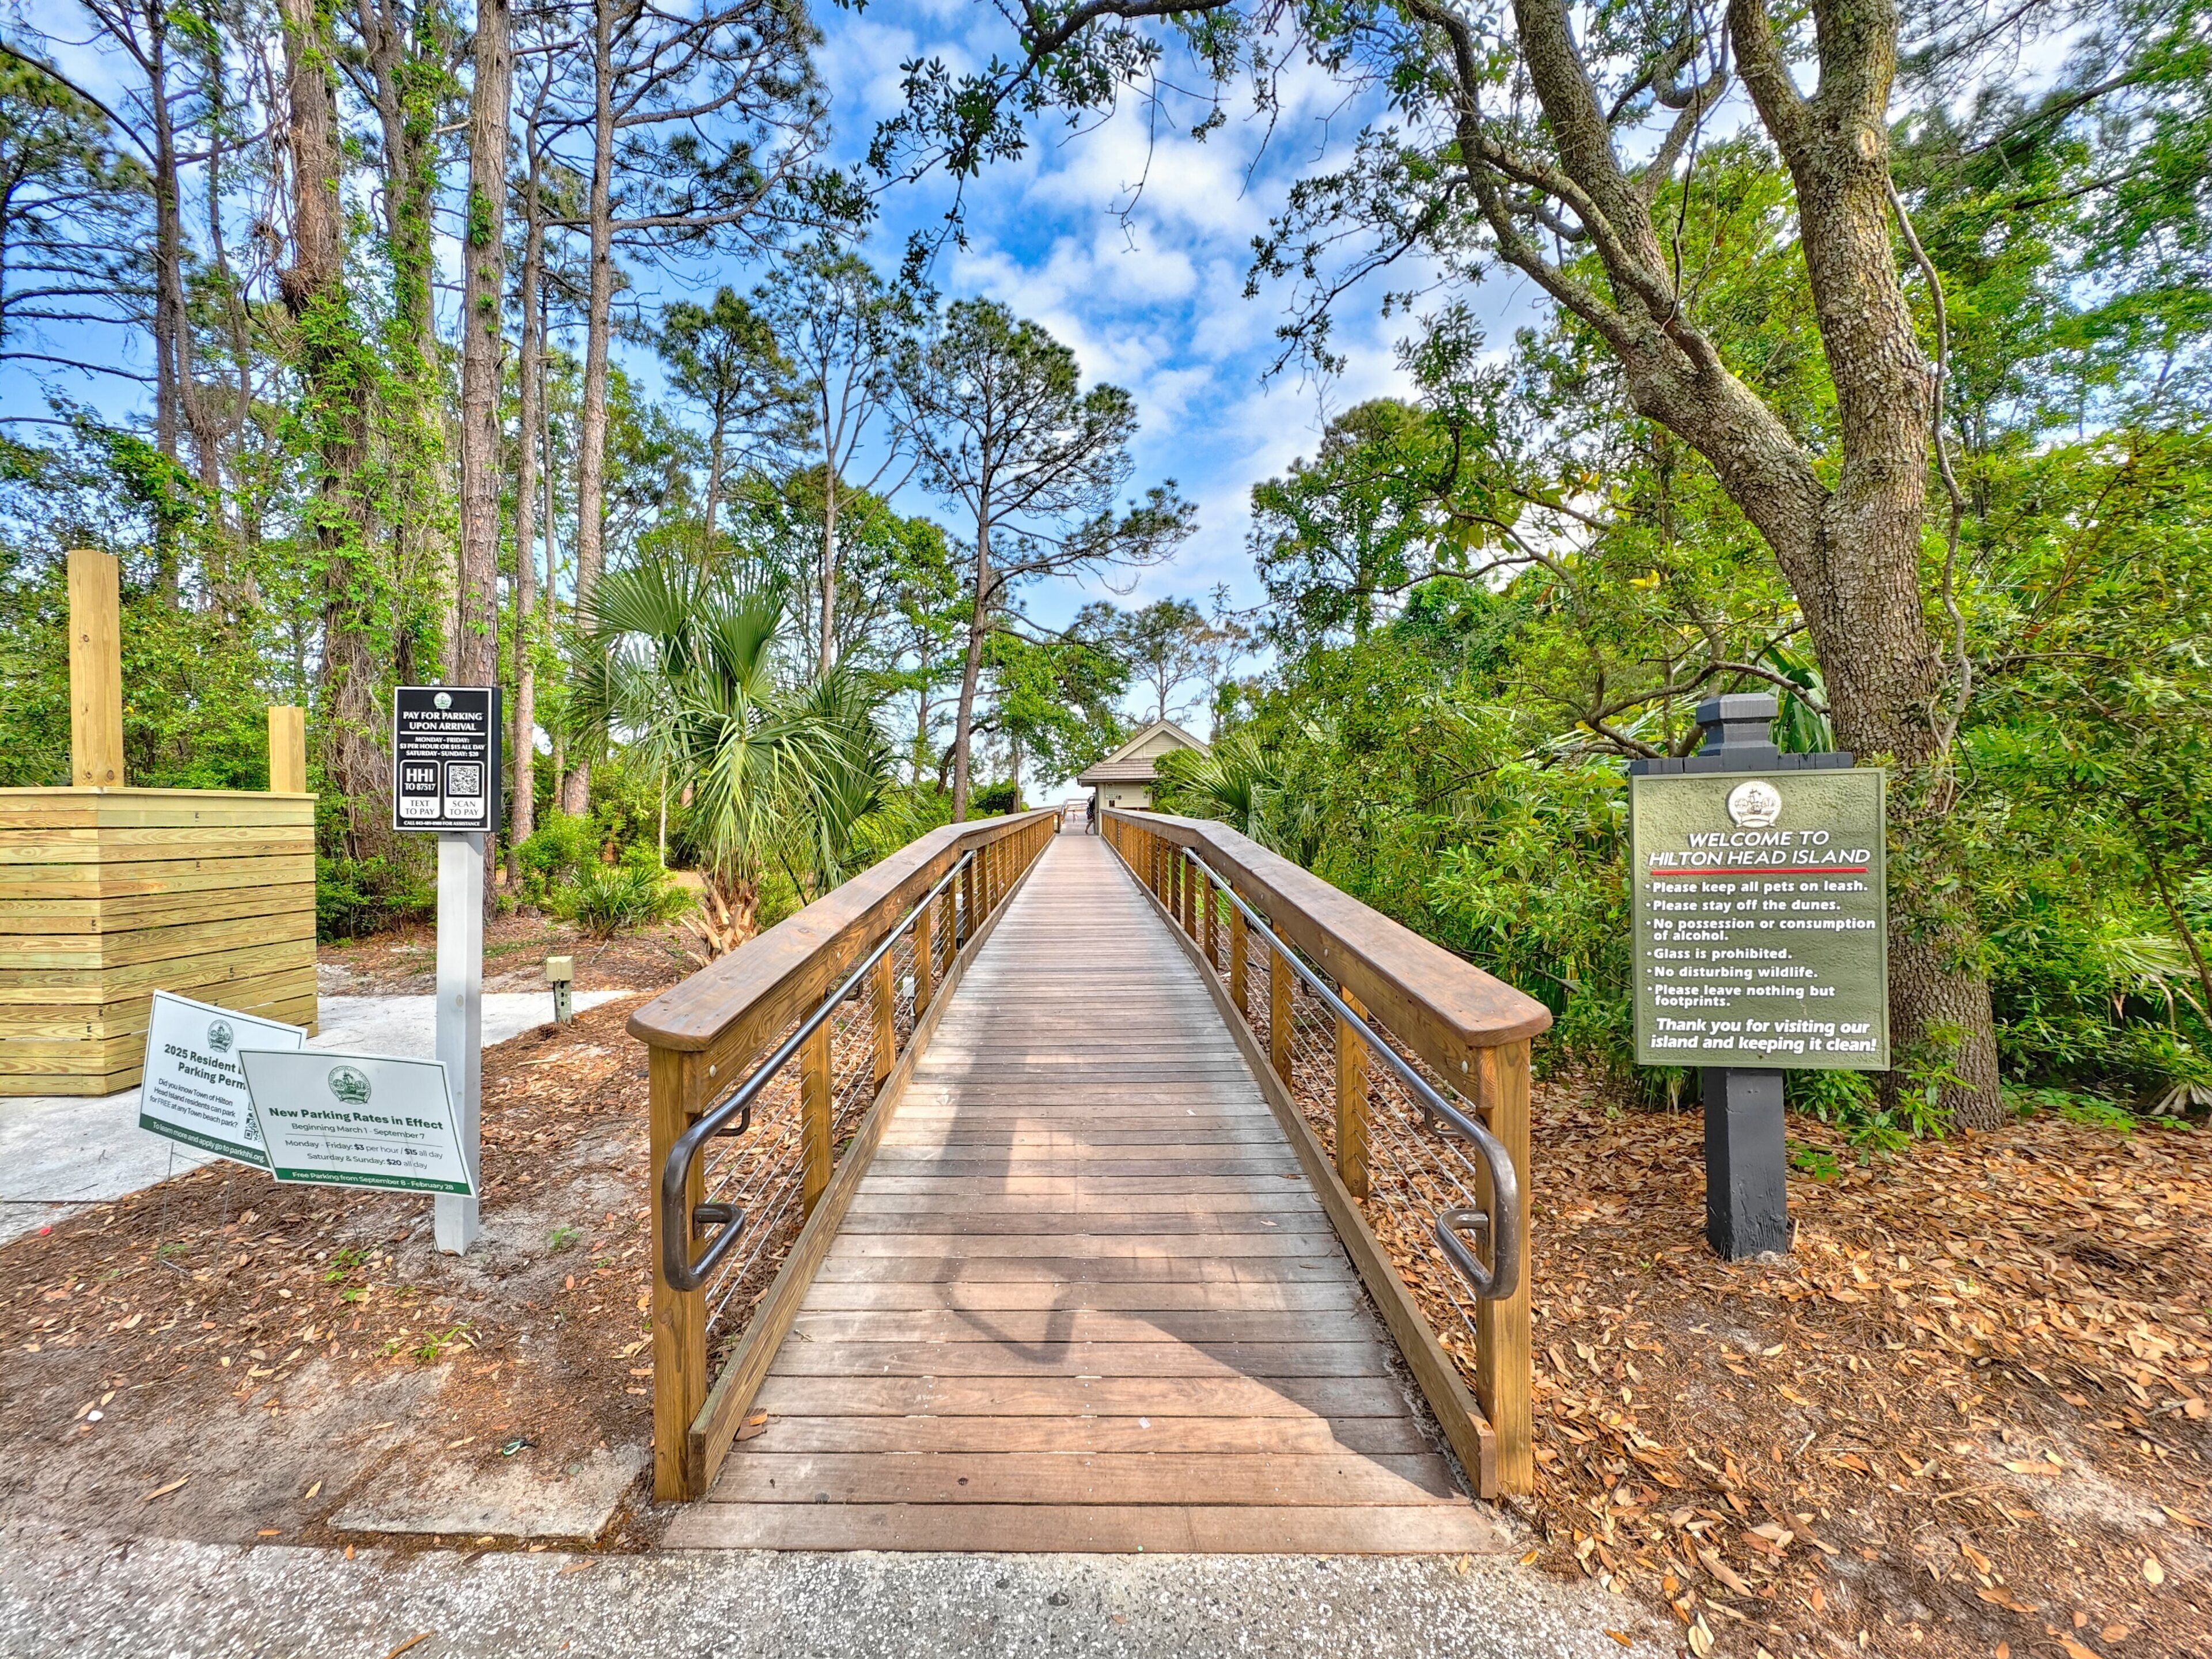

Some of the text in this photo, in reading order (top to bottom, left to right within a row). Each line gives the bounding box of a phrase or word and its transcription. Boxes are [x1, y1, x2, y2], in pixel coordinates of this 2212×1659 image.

[406, 768, 433, 782] HHI
[1688, 831, 1829, 848] WELCOME TO
[1649, 849, 1870, 866] HILTON HEAD ISLAND
[1653, 881, 1868, 895] Please keep all pets on leash.
[1653, 900, 1841, 912] Please stay off the dunes.
[1653, 918, 1876, 931] No possession or consumption
[1653, 930, 1729, 940] of alcohol.
[1654, 948, 1793, 961] Glass is prohibited.
[1654, 967, 1818, 980] No disturbing wildlife.
[1654, 984, 1835, 999] Please leave nothing but
[1654, 996, 1730, 1009] footprints.
[1656, 1017, 1870, 1037] Thank you for visiting our
[1650, 1035, 1877, 1054] island and keeping it clean!
[165, 1044, 188, 1059] 2025
[190, 1051, 236, 1073] Resident
[177, 1062, 217, 1084] Parking
[218, 1074, 246, 1090] Perm
[159, 1078, 168, 1086] Did
[179, 1084, 193, 1094] know
[194, 1089, 208, 1099] Town
[215, 1097, 233, 1106] Hilton
[154, 1086, 236, 1118] Head Island residents can park
[158, 1097, 171, 1108] FREE
[176, 1106, 187, 1114] any
[187, 1108, 202, 1119] Town
[203, 1112, 220, 1123] beach
[221, 1119, 238, 1128] park?
[268, 1107, 444, 1130] New Parking Rates in Effect
[153, 1121, 160, 1130] To
[160, 1123, 173, 1134] learn
[173, 1130, 188, 1139] more
[188, 1134, 198, 1143] and
[199, 1138, 215, 1149] apply
[214, 1143, 222, 1151] go
[291, 1123, 335, 1132] Beginning
[337, 1126, 363, 1134] March
[374, 1128, 418, 1139] September
[285, 1139, 319, 1149] Monday
[354, 1143, 365, 1151] $3
[380, 1145, 399, 1153] hour
[404, 1147, 418, 1156] $15
[429, 1150, 444, 1160] day
[307, 1153, 344, 1162] Saturday
[387, 1158, 402, 1166] $20
[413, 1160, 427, 1169] day
[310, 1173, 340, 1181] Parking
[359, 1176, 400, 1187] September
[411, 1181, 444, 1190] February
